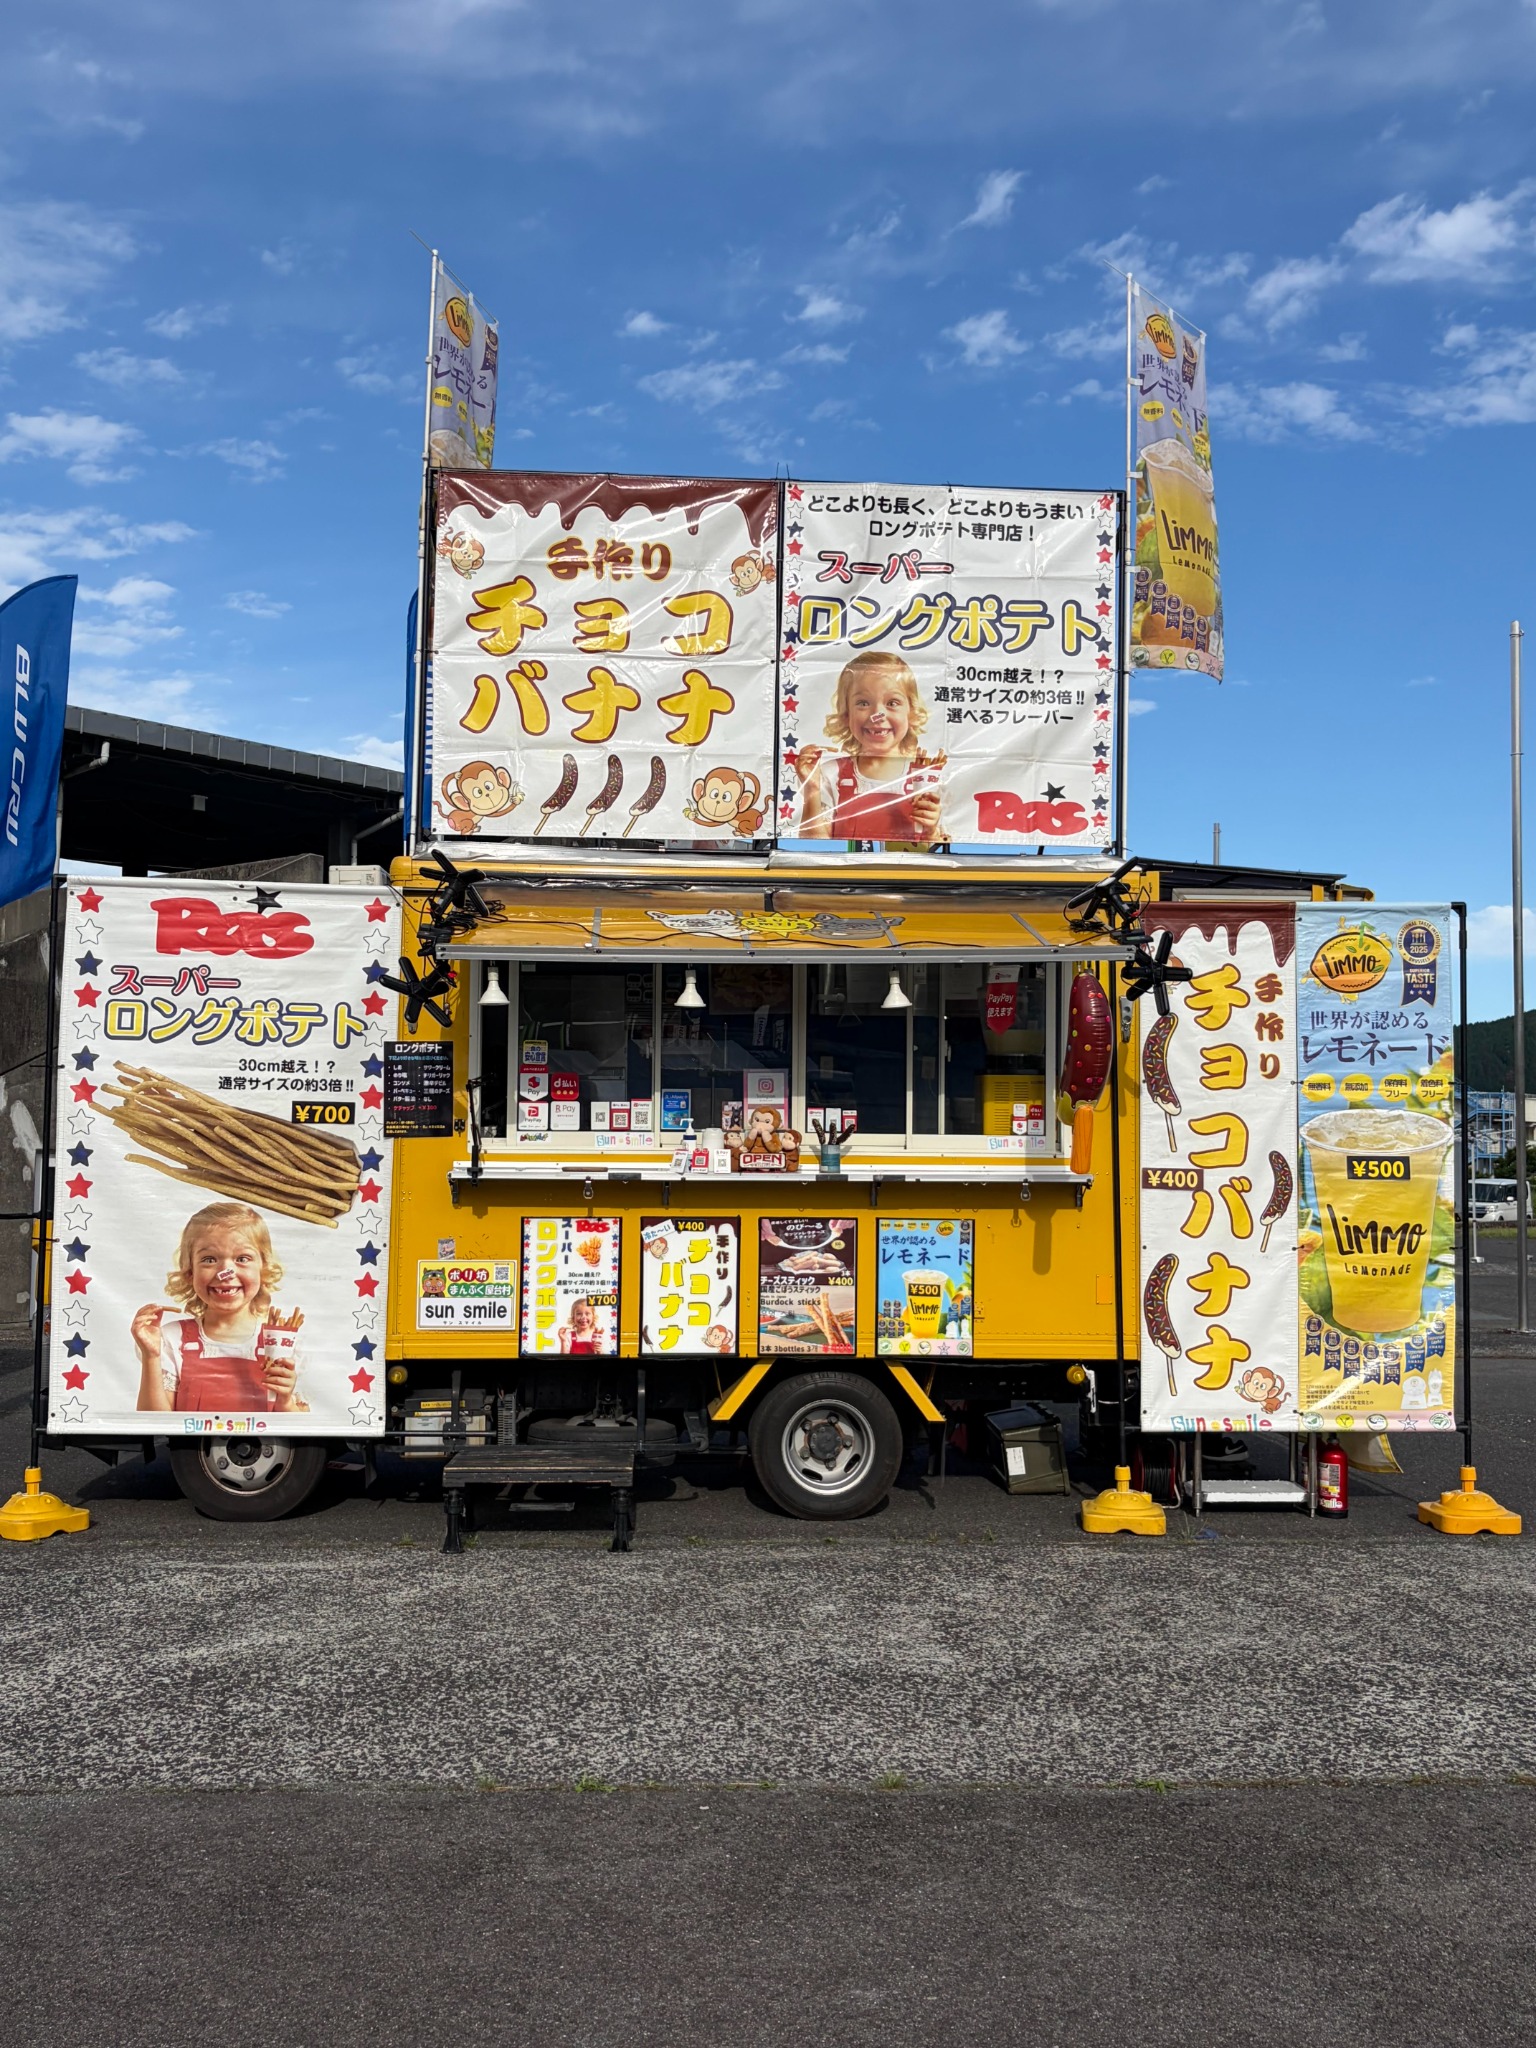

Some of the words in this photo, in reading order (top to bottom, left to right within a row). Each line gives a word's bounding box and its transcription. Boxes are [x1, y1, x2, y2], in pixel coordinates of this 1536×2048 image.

[547, 537, 672, 580] 手作り
[816, 549, 953, 584] スーパー
[466, 575, 734, 656] チョコ
[797, 592, 1102, 657] ロングポテト
[15, 643, 30, 743] BLU
[459, 660, 735, 746] バナナ
[946, 708, 1074, 725] 選べるフレーバー
[6, 750, 26, 847] CRU
[1410, 946, 1429, 954] 2025
[108, 964, 241, 996] スーパー
[1405, 973, 1435, 984] TASTE
[988, 993, 1014, 1004] PayPay
[104, 996, 368, 1049] ロングポテト
[1254, 972, 1285, 1081] 手作り
[1309, 1010, 1429, 1031] 世界が認める
[395, 1043, 442, 1053] ロングポテト
[1300, 1032, 1450, 1067] レモネード
[1385, 1090, 1409, 1098] フリー
[1422, 1090, 1444, 1098] フリー
[296, 1104, 351, 1123] ¥700
[563, 1105, 576, 1113] Pay
[742, 1154, 782, 1165] OPEN
[1180, 962, 1254, 1391] チョコバナナ
[1352, 1159, 1405, 1179] ¥500
[1147, 1170, 1198, 1188] ¥400
[677, 1222, 704, 1231] ¥400
[881, 1234, 937, 1246] 世界が認める
[716, 1234, 730, 1280] 手作り
[882, 1247, 970, 1266] レモネード
[687, 1238, 713, 1326] チョコ
[760, 1275, 815, 1285] チーズスティック
[828, 1277, 853, 1286] ¥400
[910, 1284, 939, 1295] ¥500
[588, 1295, 617, 1305] ¥700
[658, 1258, 687, 1351] バナナ
[760, 1298, 794, 1306] Burdock
[797, 1298, 821, 1306] sticks
[425, 1304, 455, 1319] sun
[463, 1301, 507, 1319] smile
[226, 1416, 267, 1432] smile
[1222, 1414, 1272, 1432] smile
